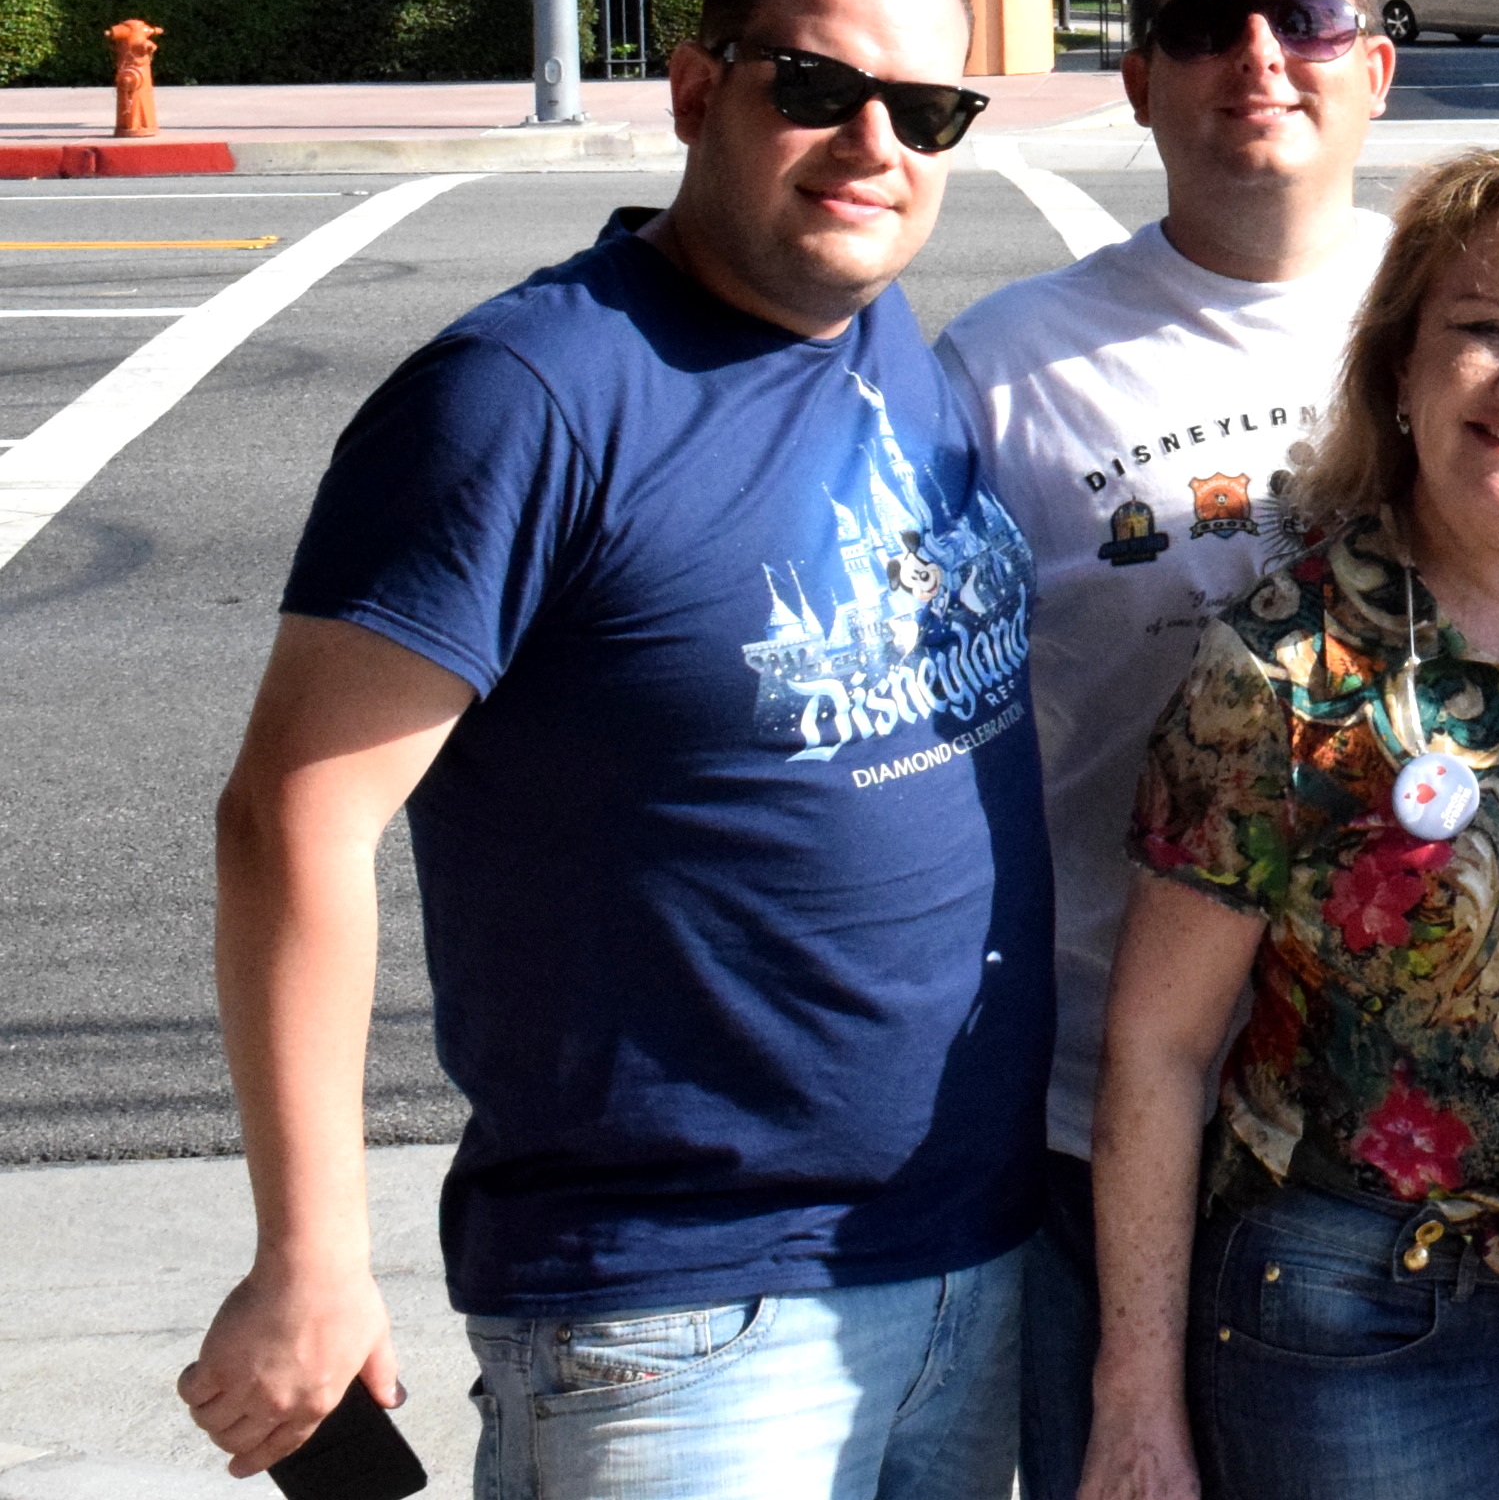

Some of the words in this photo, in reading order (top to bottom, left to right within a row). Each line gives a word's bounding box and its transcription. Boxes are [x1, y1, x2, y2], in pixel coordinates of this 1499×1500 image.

[1084, 405, 1318, 492] DISNEYLAN
[785, 582, 1030, 763] Disneyland
[852, 742, 953, 789] DIAMOND
[950, 701, 1026, 756] CELEBRATION
